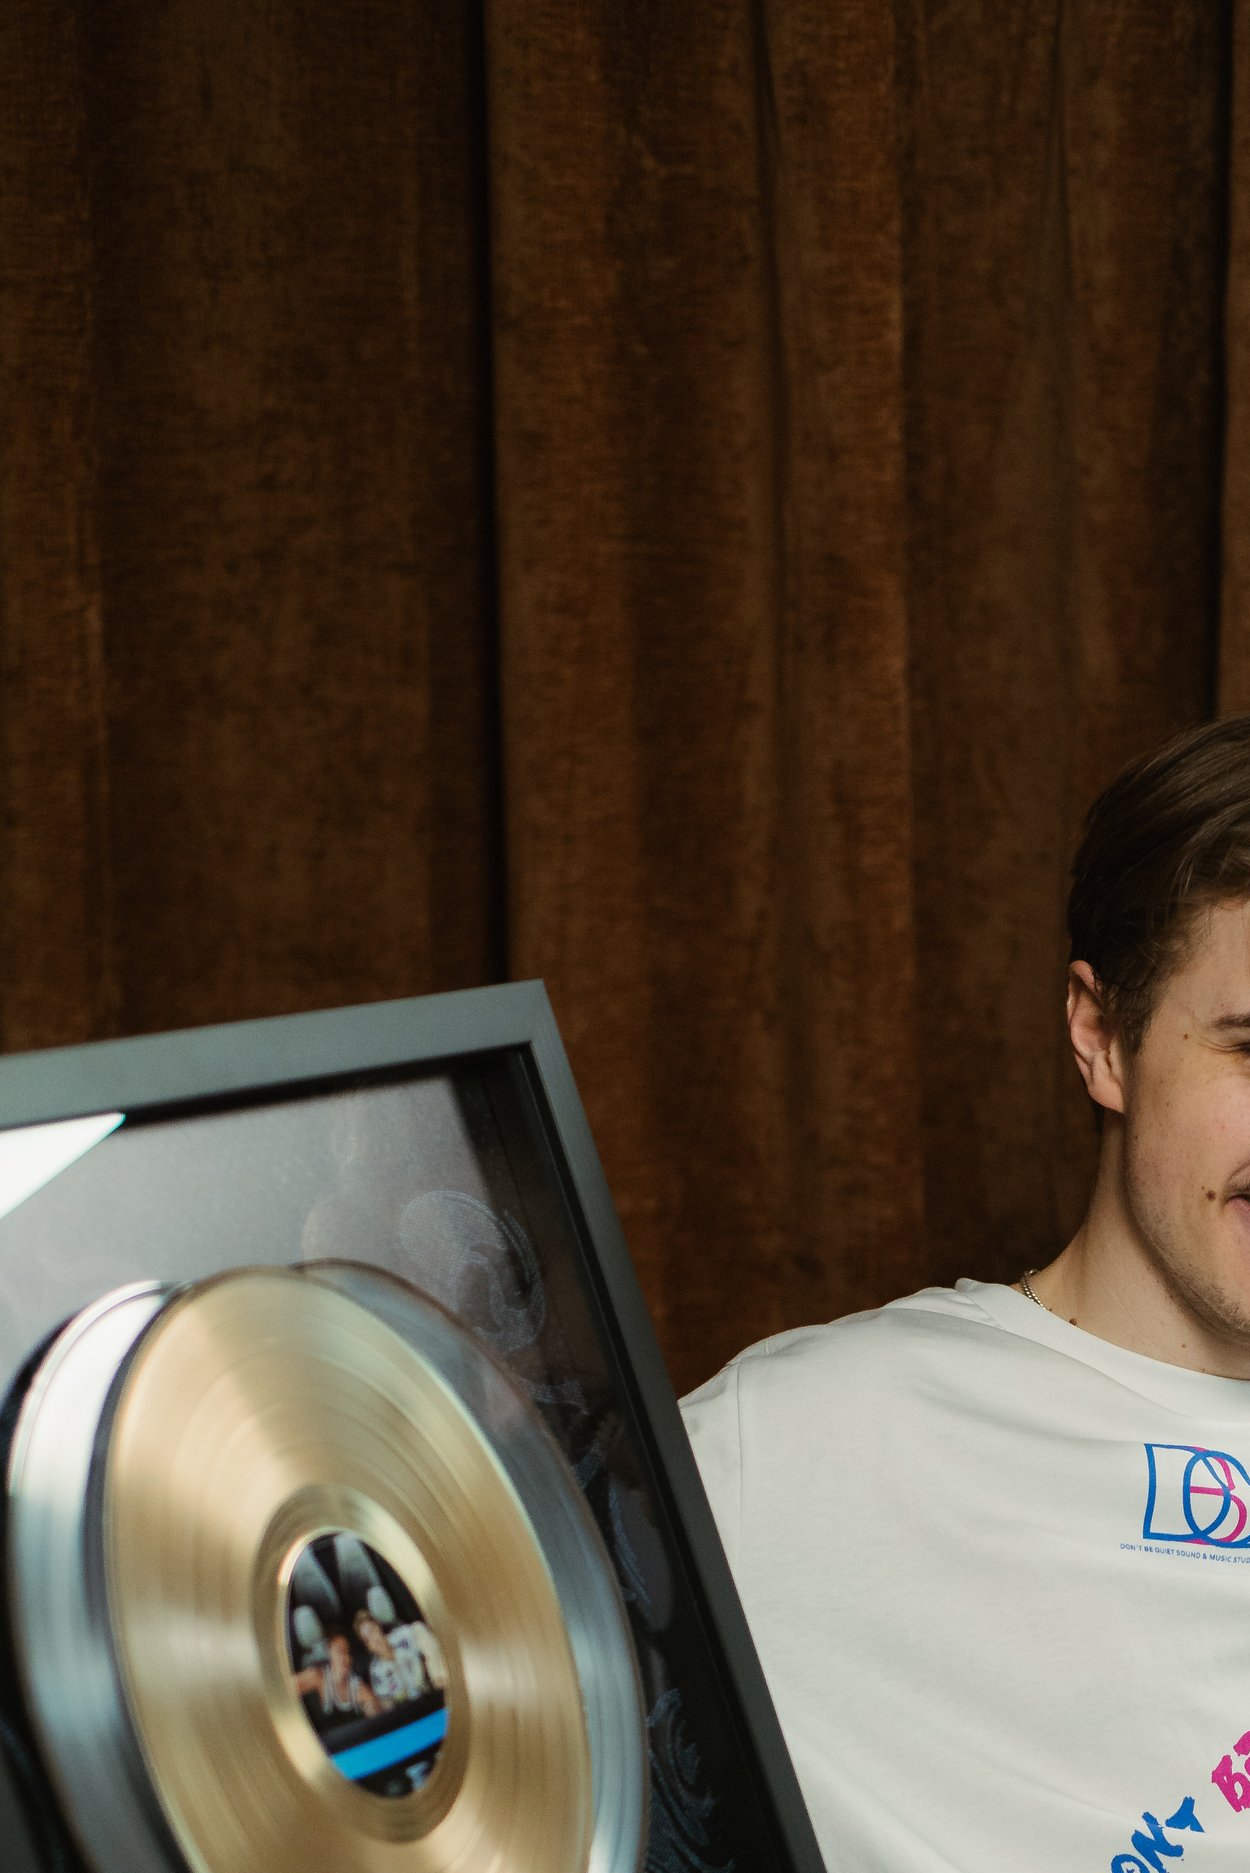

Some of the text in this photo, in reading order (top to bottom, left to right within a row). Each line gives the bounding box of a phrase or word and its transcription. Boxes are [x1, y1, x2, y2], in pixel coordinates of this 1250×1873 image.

[1154, 1547, 1174, 1556] QUIET
[1176, 1550, 1201, 1559] SOUND
[1209, 1554, 1232, 1563] MUSIC
